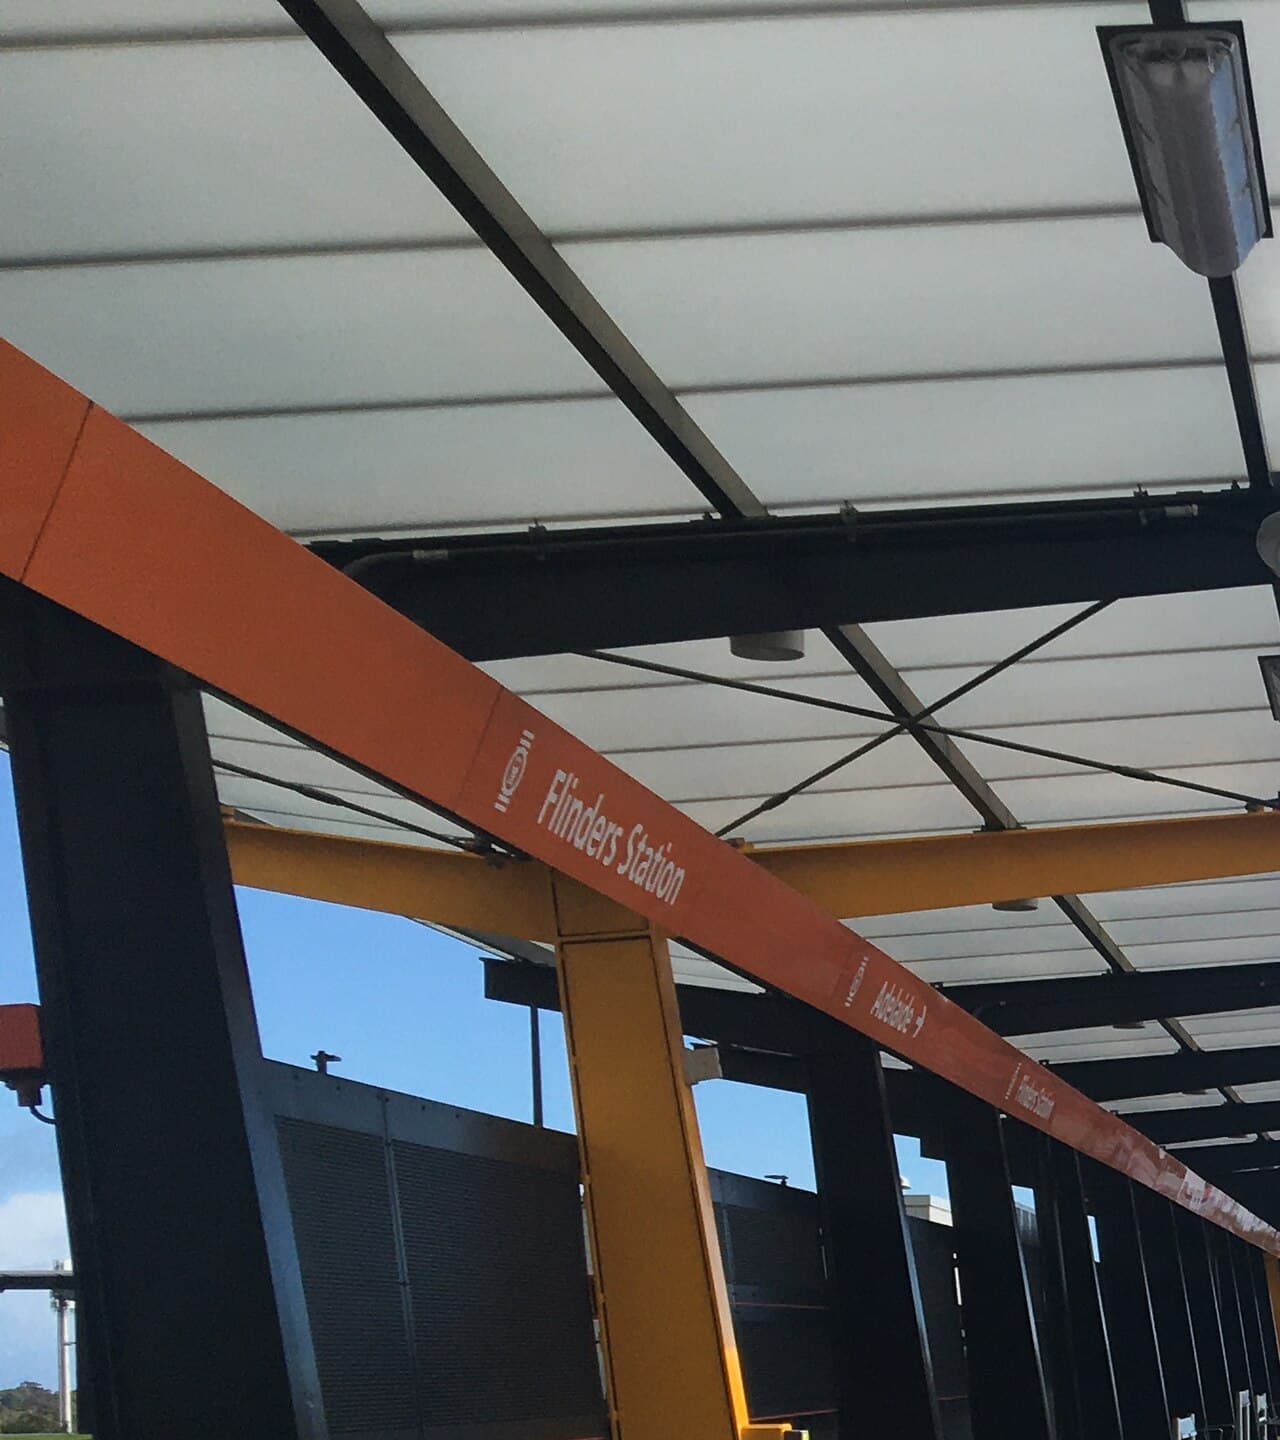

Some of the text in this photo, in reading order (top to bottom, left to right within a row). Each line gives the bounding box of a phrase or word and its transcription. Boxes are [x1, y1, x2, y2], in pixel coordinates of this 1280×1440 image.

[537, 768, 624, 867] Flinders
[617, 823, 685, 906] Station
[870, 981, 914, 1034] Adelaide
